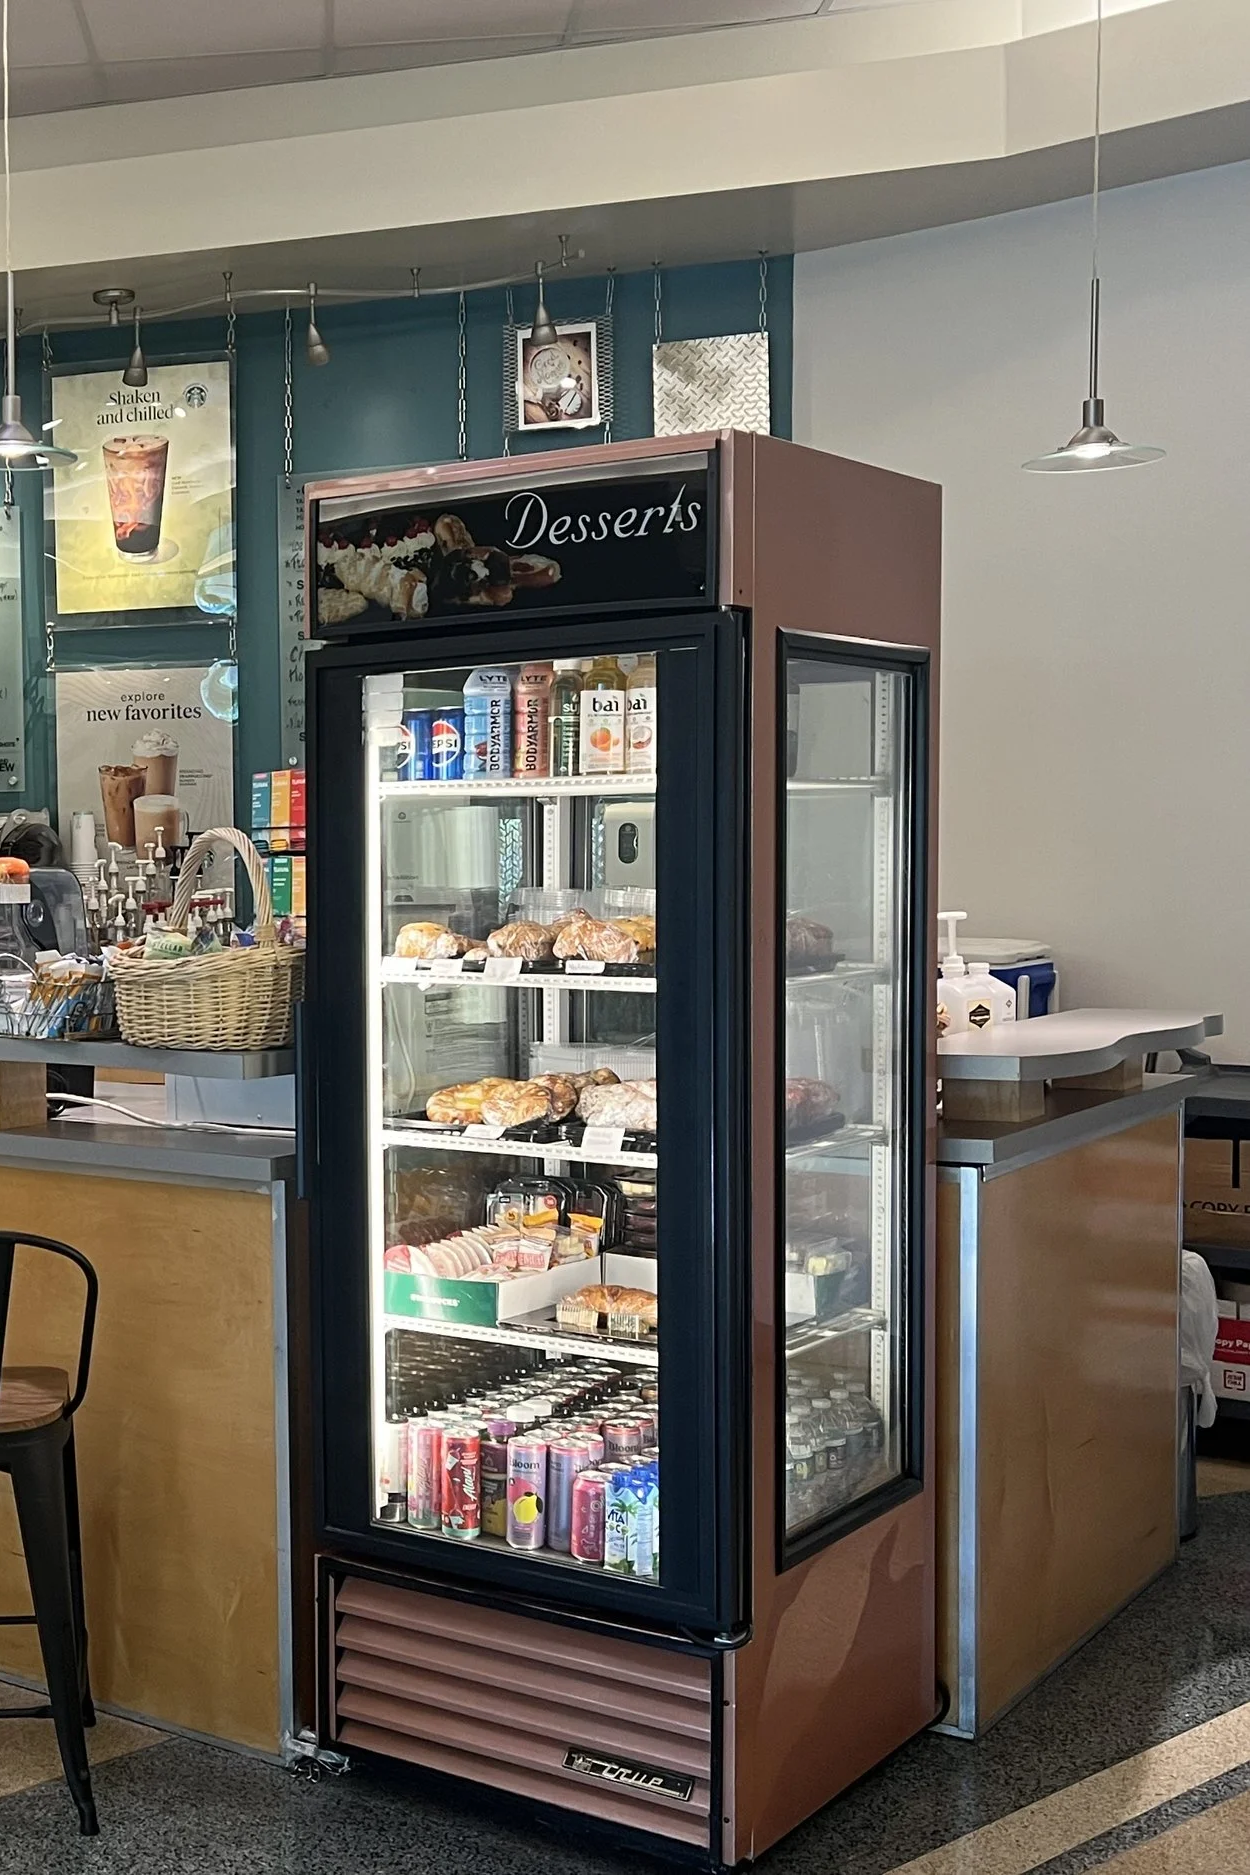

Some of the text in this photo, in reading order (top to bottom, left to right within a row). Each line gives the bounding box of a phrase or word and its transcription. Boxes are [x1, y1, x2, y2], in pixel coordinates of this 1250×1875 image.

[109, 389, 160, 405] Shaken
[97, 403, 173, 425] and chilled
[505, 483, 701, 549] Desserts
[121, 692, 165, 703] explore
[87, 703, 202, 722] new favorites
[1215, 1338, 1235, 1348] opy
